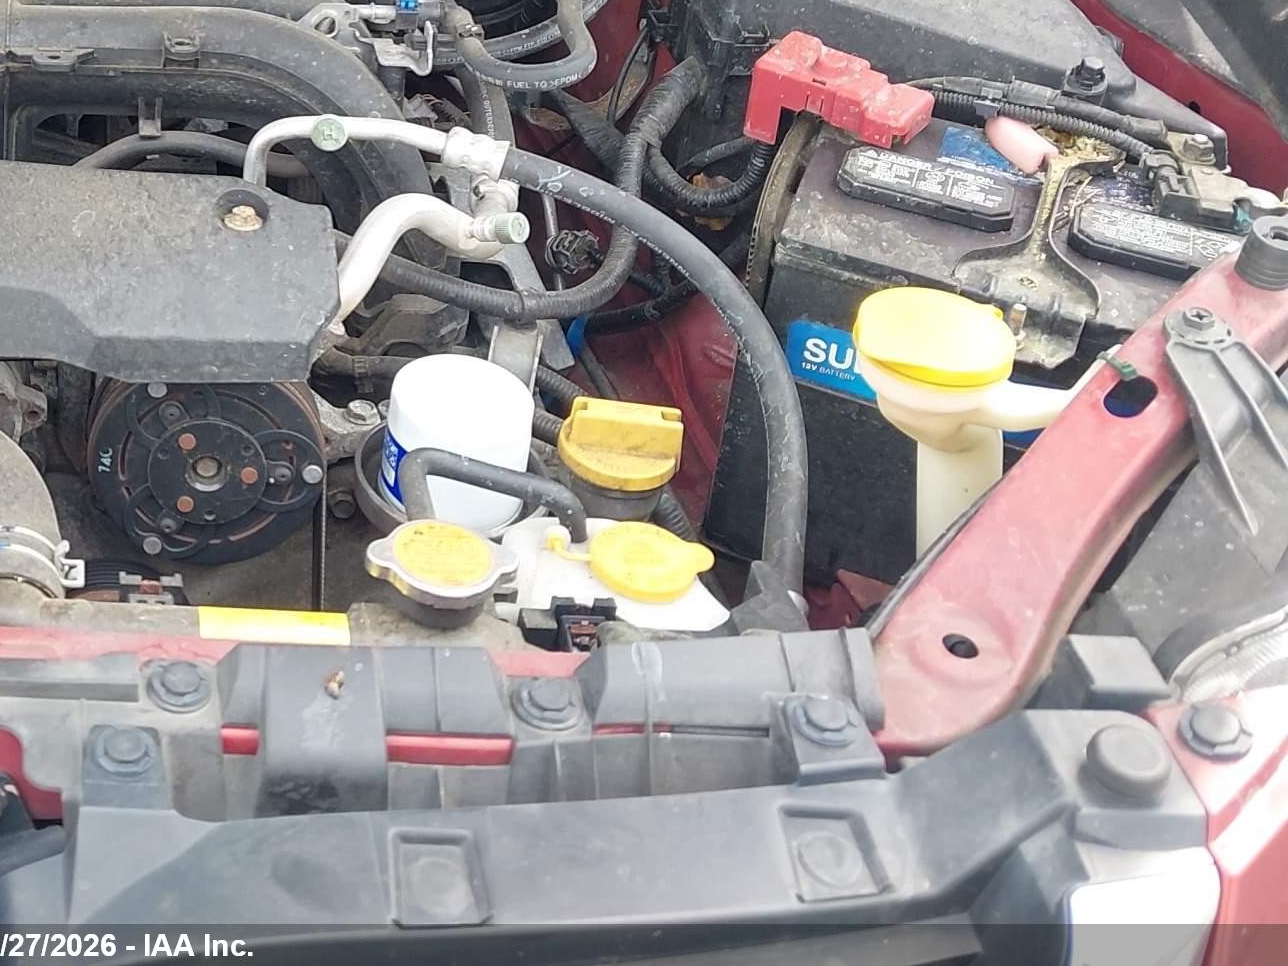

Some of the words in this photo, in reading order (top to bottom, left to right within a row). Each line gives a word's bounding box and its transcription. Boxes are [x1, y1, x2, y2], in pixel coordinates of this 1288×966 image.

[945, 167, 995, 185] POISON
[803, 337, 857, 374] SU
[801, 361, 817, 371] 12V
[818, 366, 856, 381] BATTERY
